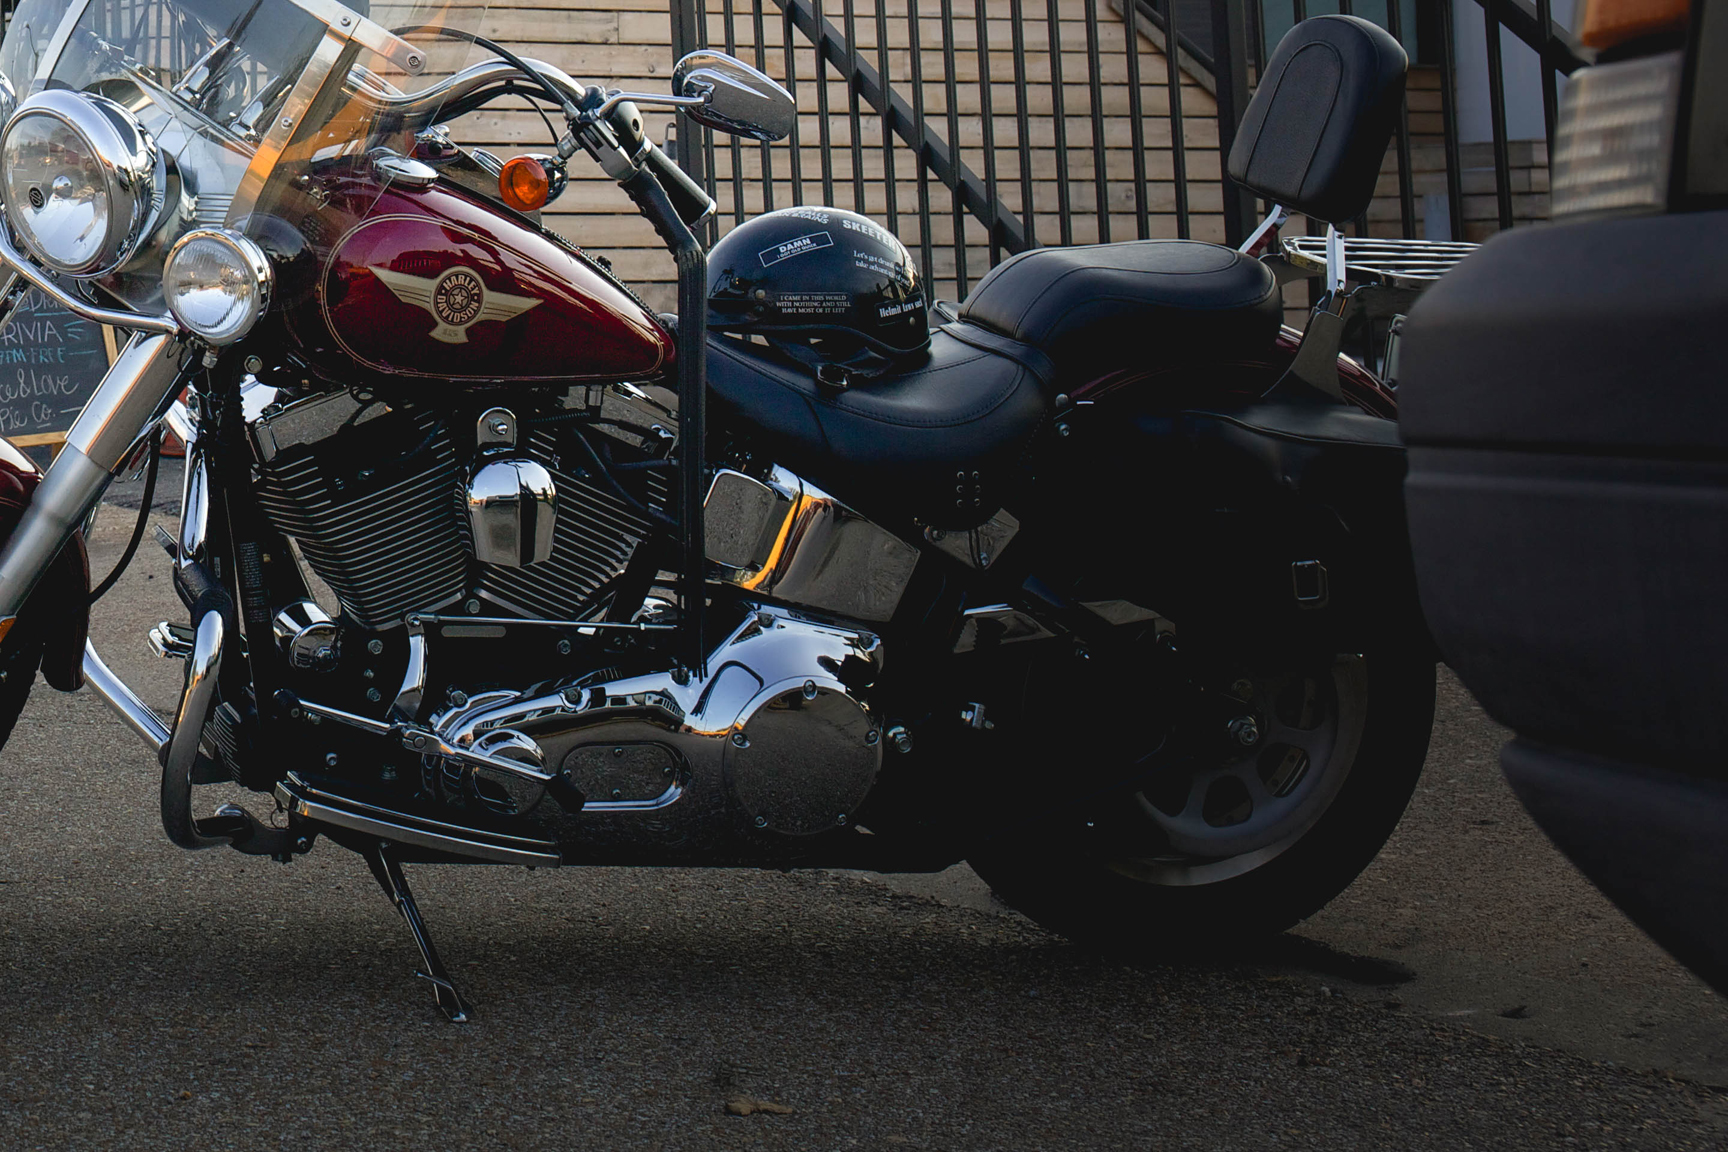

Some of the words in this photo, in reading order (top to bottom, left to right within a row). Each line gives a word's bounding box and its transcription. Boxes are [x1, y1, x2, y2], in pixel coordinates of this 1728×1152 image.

[779, 237, 811, 253] DAMN
[853, 250, 868, 260] Let's
[855, 260, 869, 269] take
[443, 274, 480, 295] HARLEY
[437, 295, 479, 323] DAVIDSON
[32, 401, 56, 423] Co.
